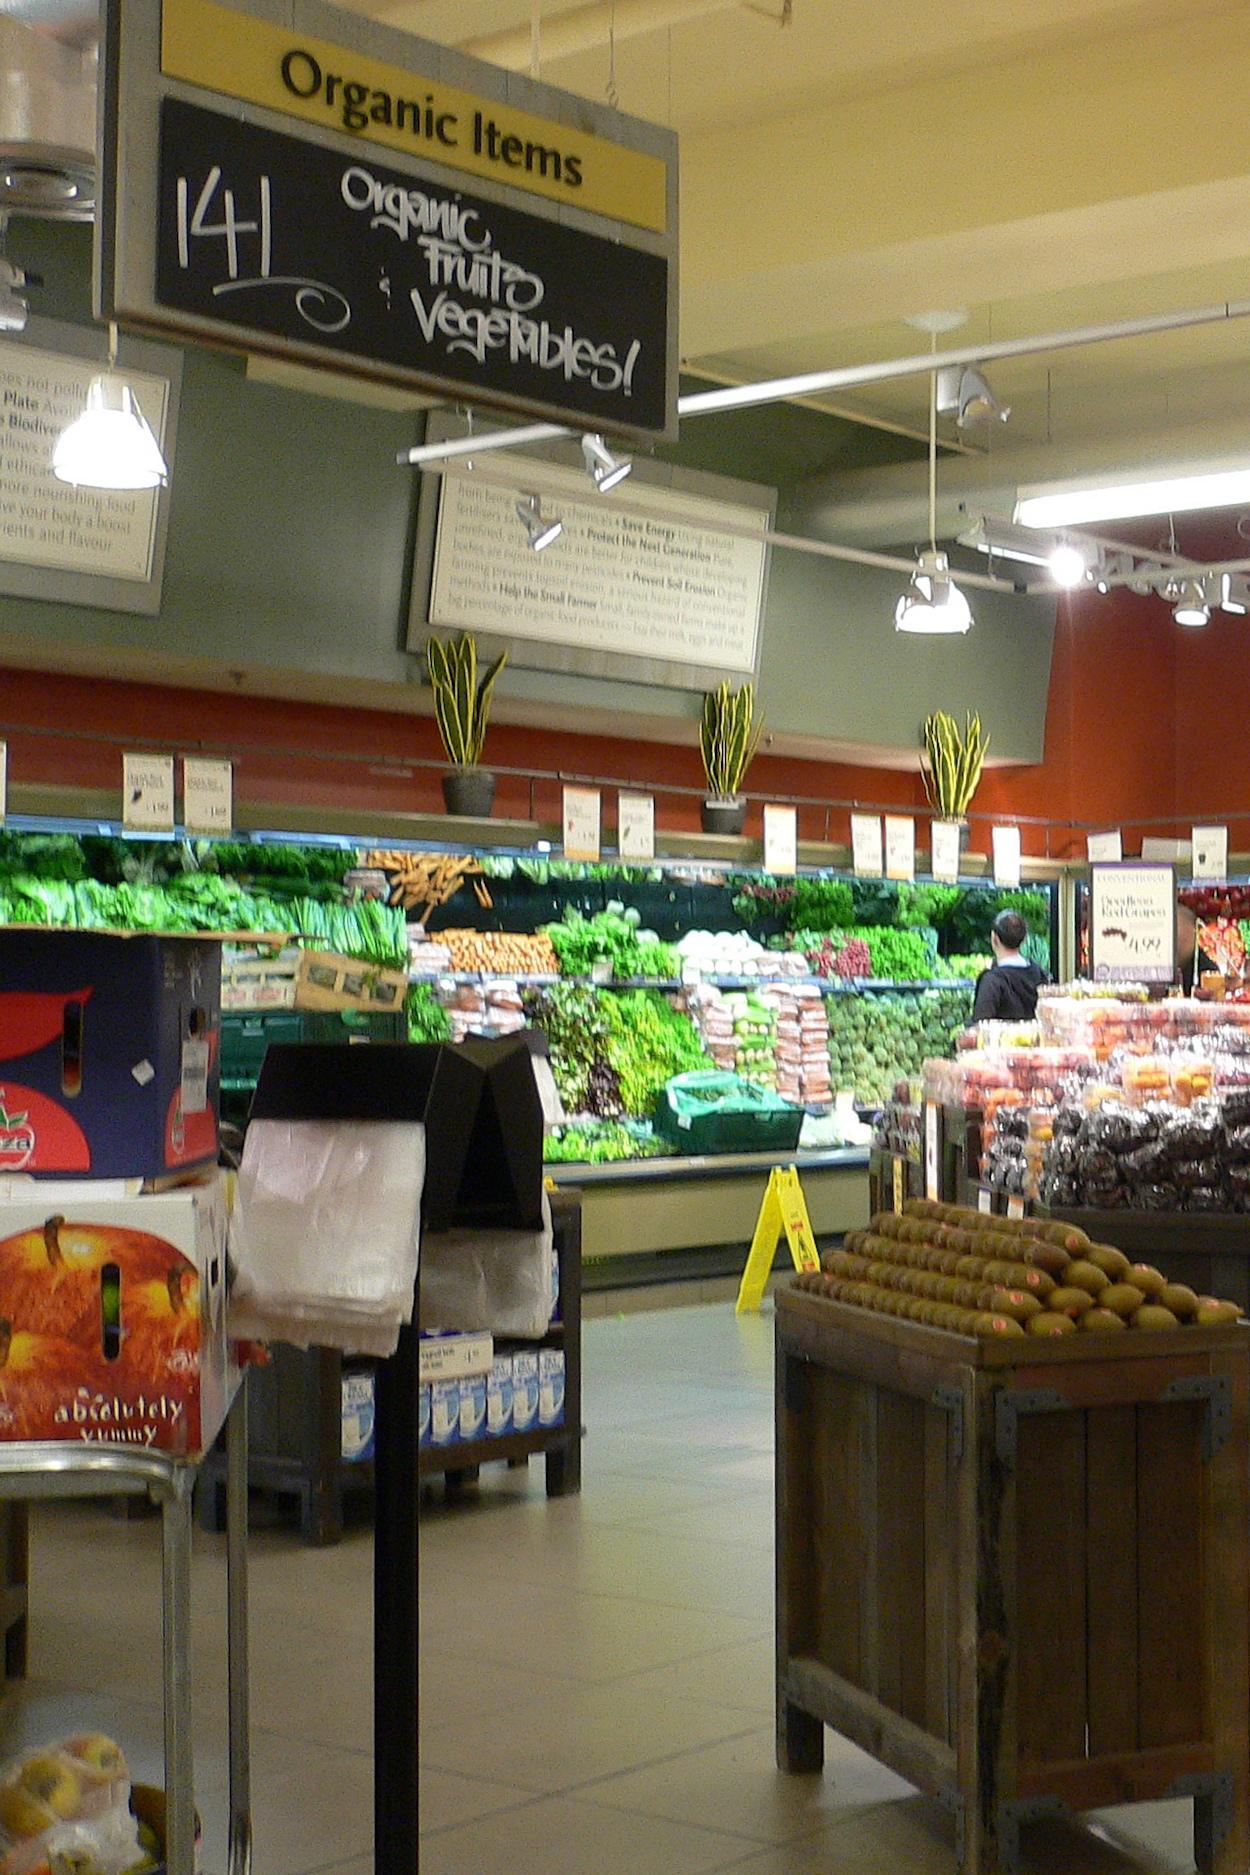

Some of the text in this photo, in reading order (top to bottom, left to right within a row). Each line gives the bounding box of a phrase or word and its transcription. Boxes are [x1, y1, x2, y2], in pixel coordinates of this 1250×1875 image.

[281, 49, 583, 187] Organic Items
[341, 166, 492, 251] Organic
[4, 390, 39, 409] Plate
[587, 527, 620, 544] Protect
[622, 534, 638, 548] the
[646, 521, 676, 540] Energy
[632, 571, 666, 588] Prevent
[500, 582, 522, 600] Help
[524, 586, 539, 600] the
[54, 1394, 182, 1426] absolutely
[80, 1424, 157, 1448] yummy
